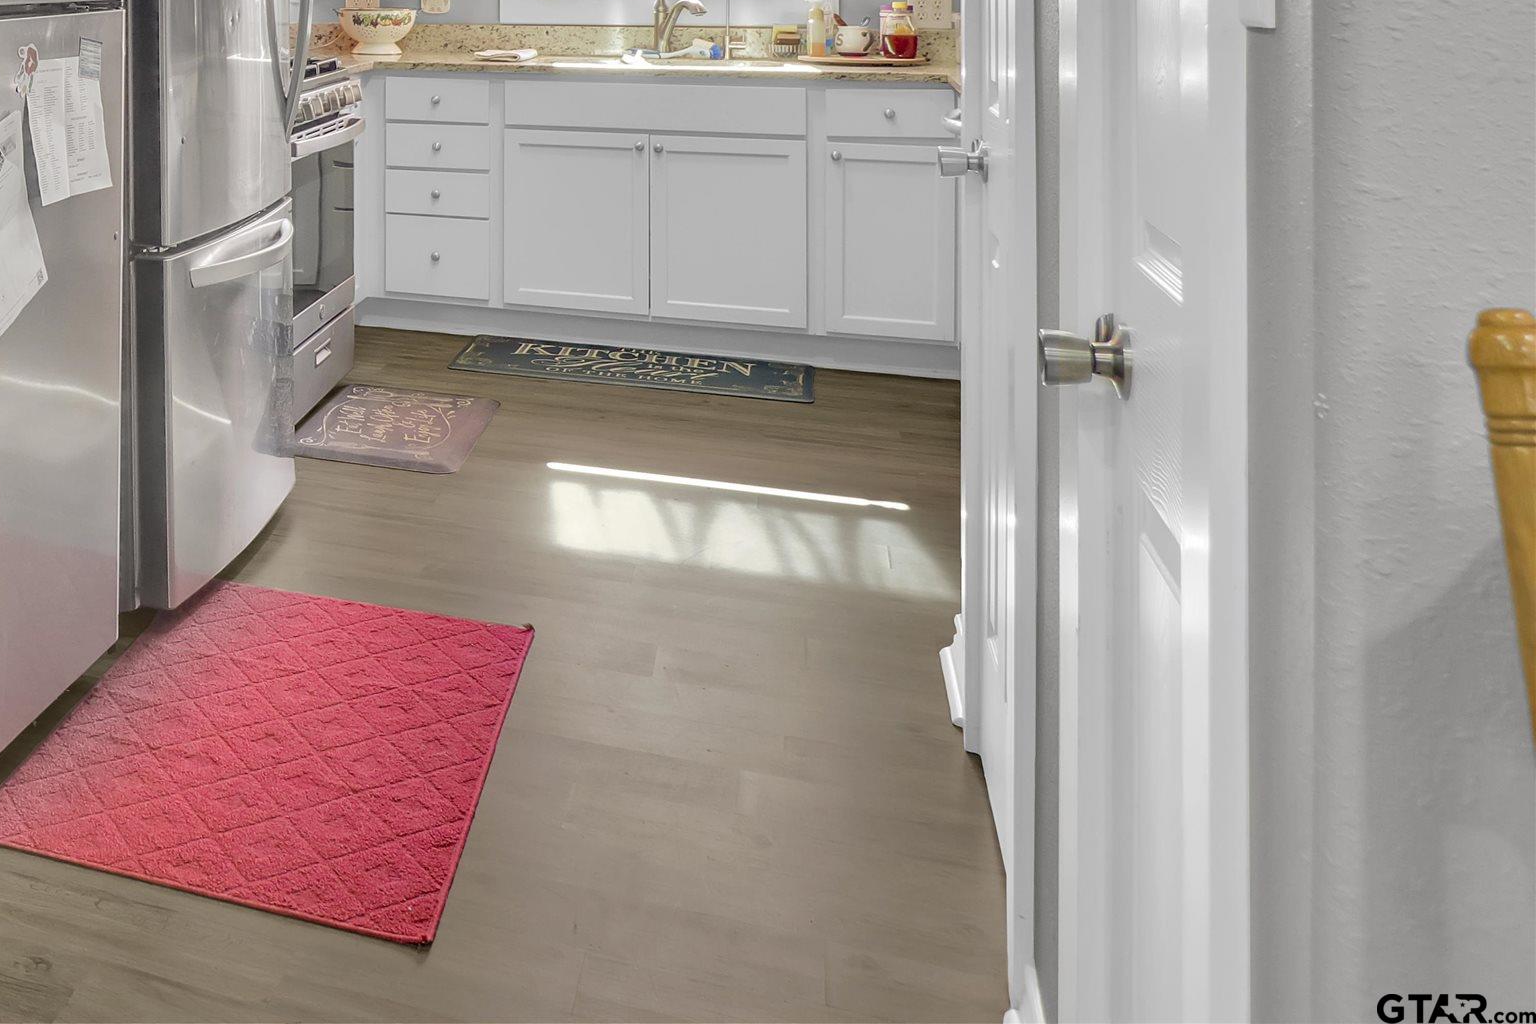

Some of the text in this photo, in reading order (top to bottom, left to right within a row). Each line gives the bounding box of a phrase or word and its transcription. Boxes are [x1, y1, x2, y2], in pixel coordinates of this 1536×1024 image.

[510, 341, 757, 377] KITCHEN
[531, 355, 720, 380] Heart
[637, 374, 707, 385] HOME
